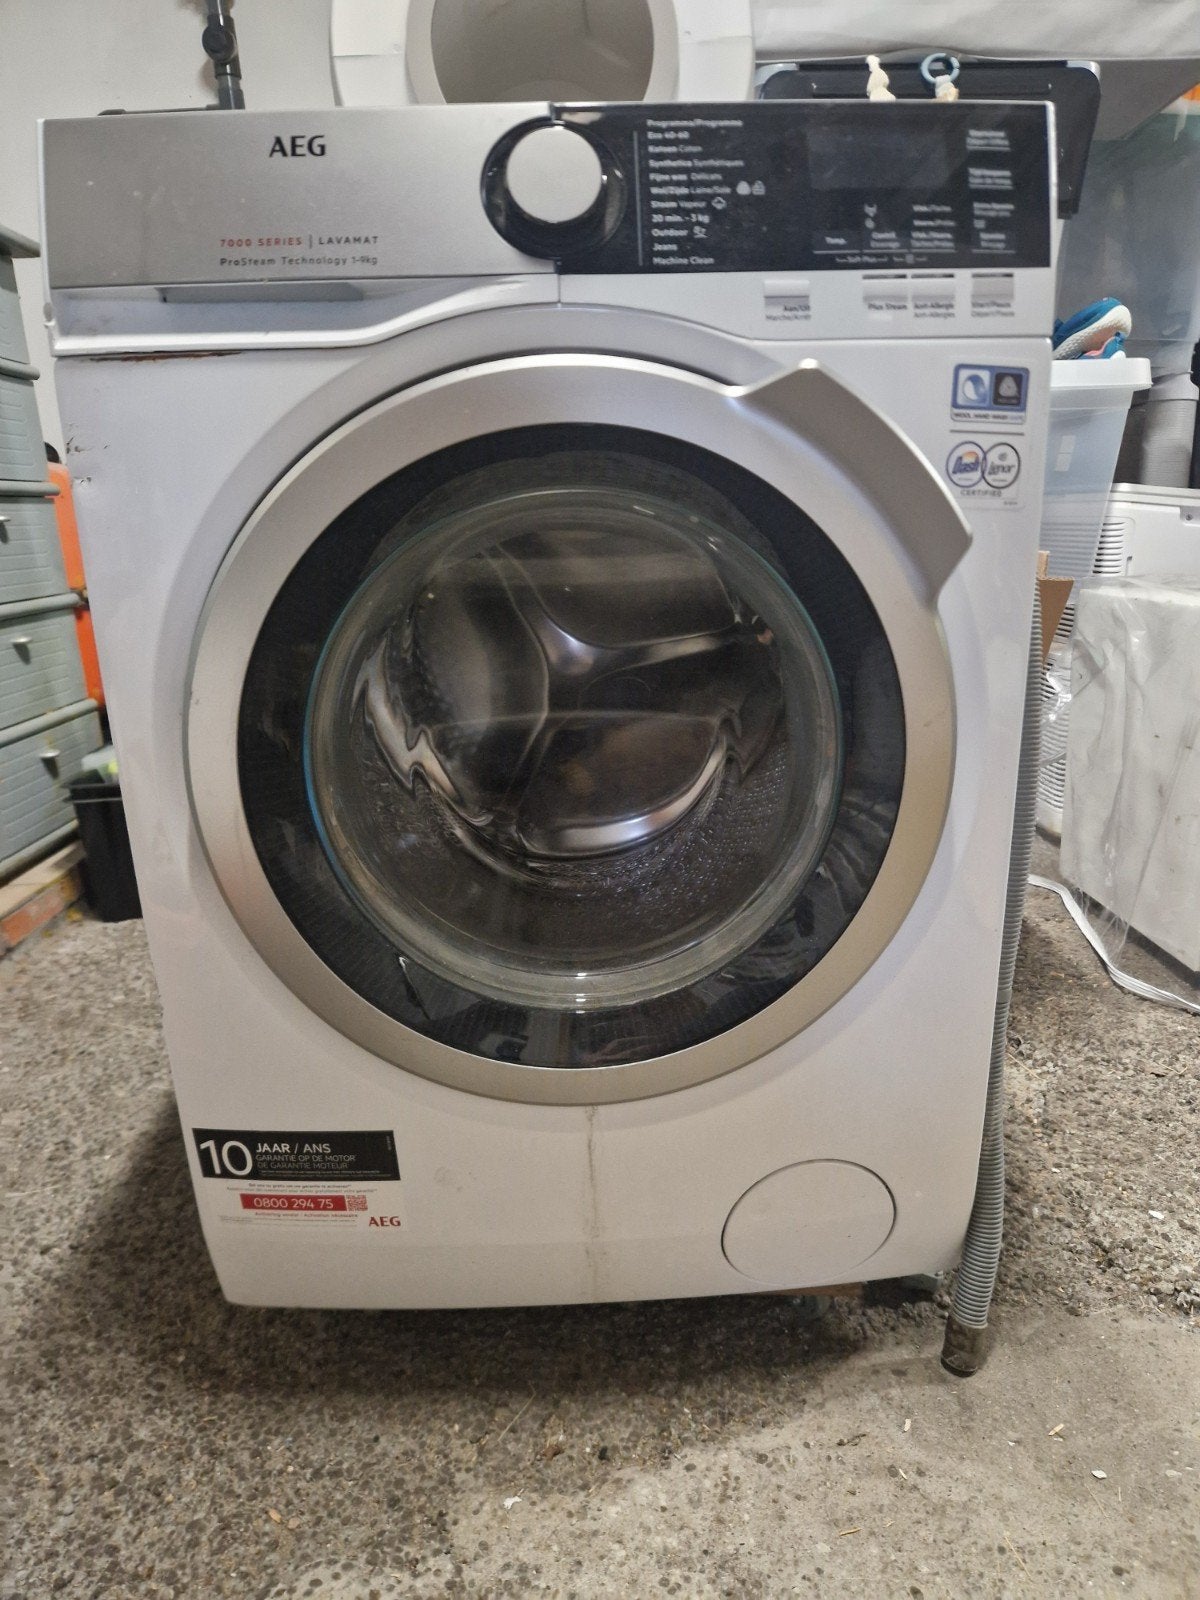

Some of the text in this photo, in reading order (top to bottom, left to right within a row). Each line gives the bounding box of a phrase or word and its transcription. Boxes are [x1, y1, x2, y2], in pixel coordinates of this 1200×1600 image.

[268, 134, 327, 158] AEG
[220, 235, 379, 247] 7000 SERIES LAVAMAT
[652, 242, 678, 252] Jeans
[219, 256, 276, 266] ProSteam
[281, 255, 348, 266] Technology
[652, 256, 689, 266] Machine
[960, 488, 1002, 498] CERTIFIED
[256, 1142, 291, 1154] JAAR
[302, 1142, 332, 1154] ANS
[200, 1139, 254, 1177] 10
[255, 1154, 296, 1162] GARANTIE
[298, 1154, 310, 1162] OP
[312, 1154, 323, 1162] DE
[270, 1161, 310, 1169] GARANTIE
[253, 1197, 335, 1210] 0800 294 75
[368, 1215, 402, 1228] AEG
